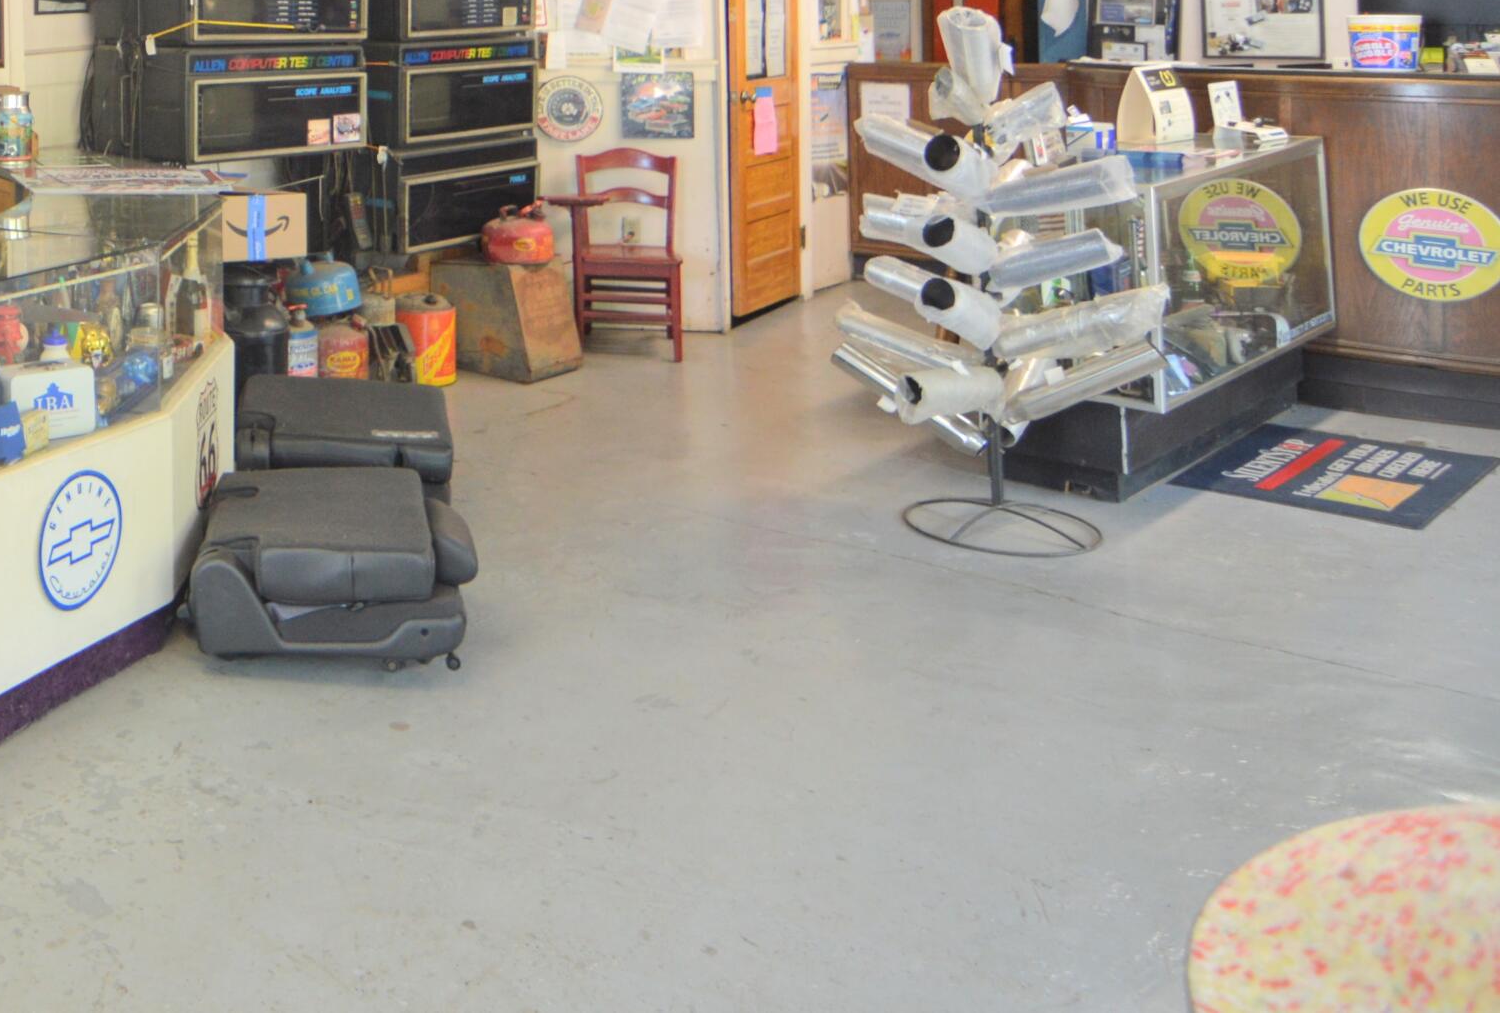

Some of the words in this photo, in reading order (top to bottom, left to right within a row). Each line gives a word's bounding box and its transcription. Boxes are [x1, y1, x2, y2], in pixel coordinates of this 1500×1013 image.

[193, 59, 227, 74] ALLEN
[228, 56, 288, 72] COMPUTER
[289, 55, 315, 69] TEST
[316, 53, 355, 68] CENTER
[430, 48, 476, 62] COMPUTER
[1399, 192, 1430, 208] WE
[1437, 193, 1473, 215] USE
[1397, 213, 1470, 235] Genuine
[1380, 240, 1491, 264] CHEVROLET
[1401, 277, 1462, 298] PARTS
[199, 420, 217, 488] 66
